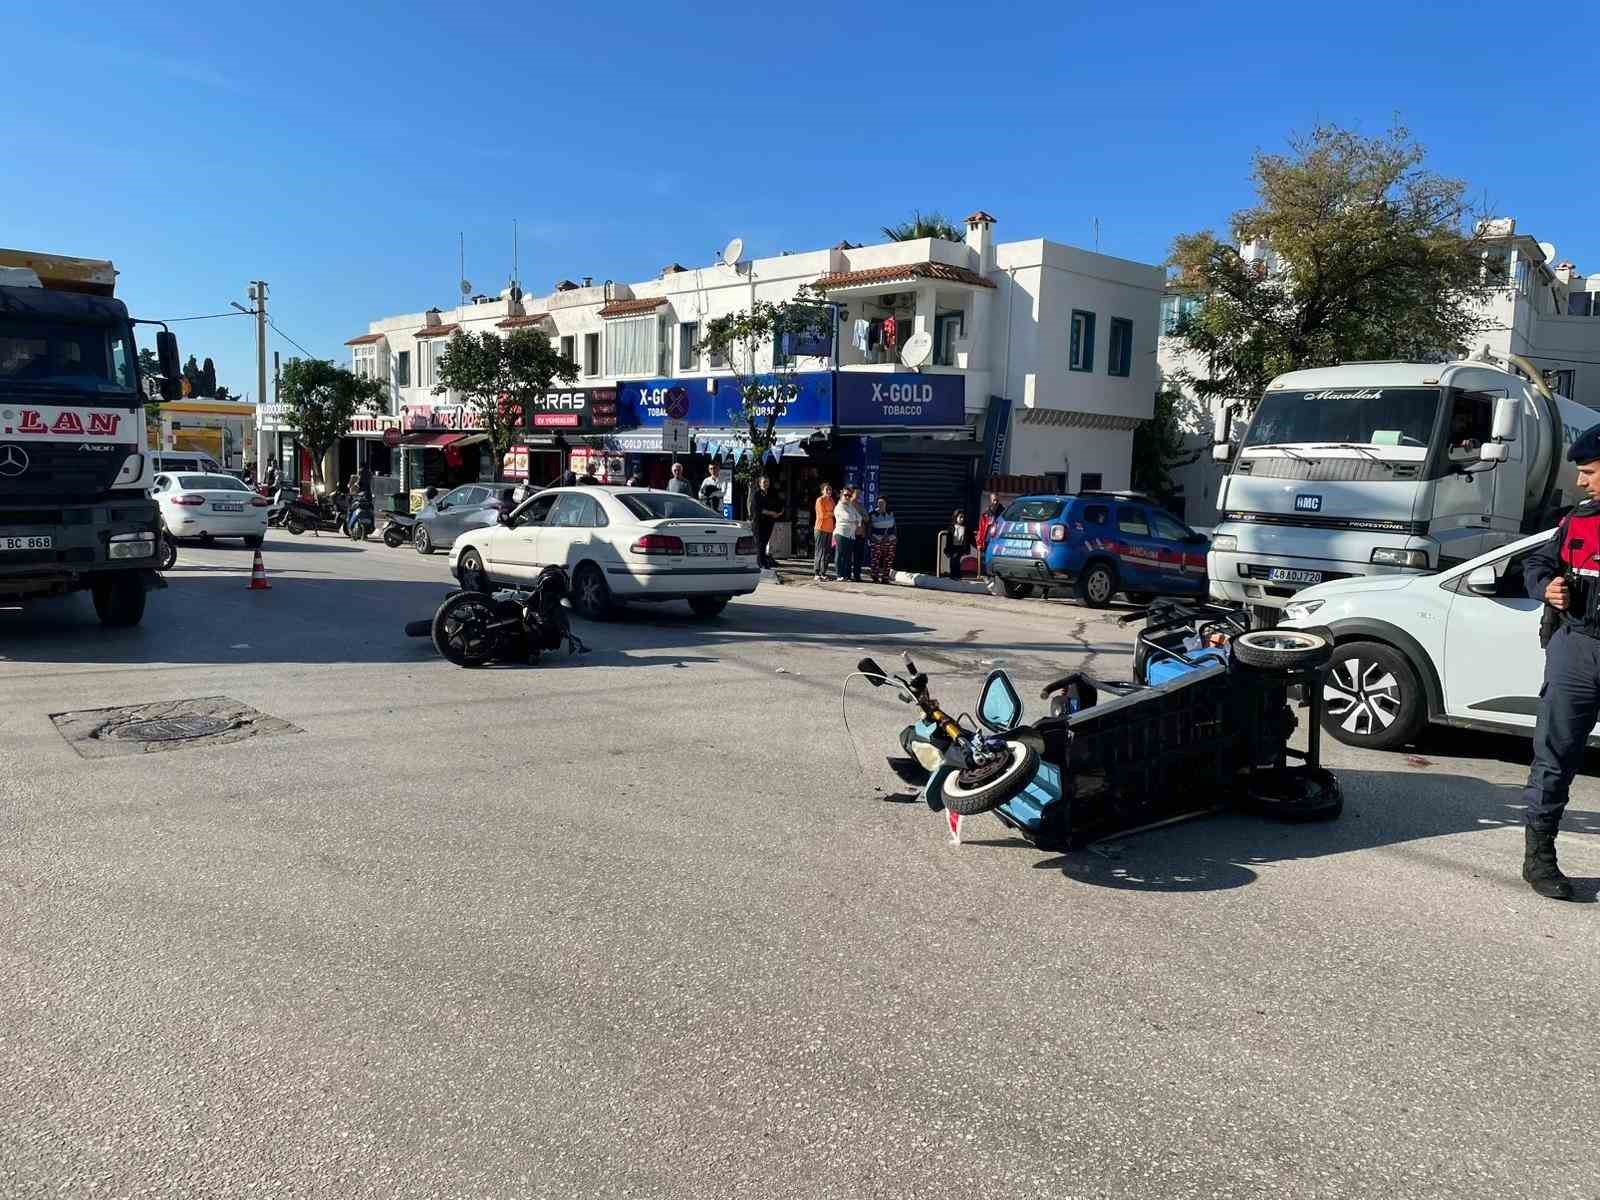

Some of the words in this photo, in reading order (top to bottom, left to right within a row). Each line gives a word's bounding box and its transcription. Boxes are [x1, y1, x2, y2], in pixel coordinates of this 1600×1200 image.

[640, 388, 668, 406] X-GO
[742, 385, 798, 404] XGOLD
[872, 383, 933, 402] X-GOLD
[647, 407, 668, 417] TOBA
[882, 405, 922, 416] TOBACCO
[28, 537, 50, 548] 868
